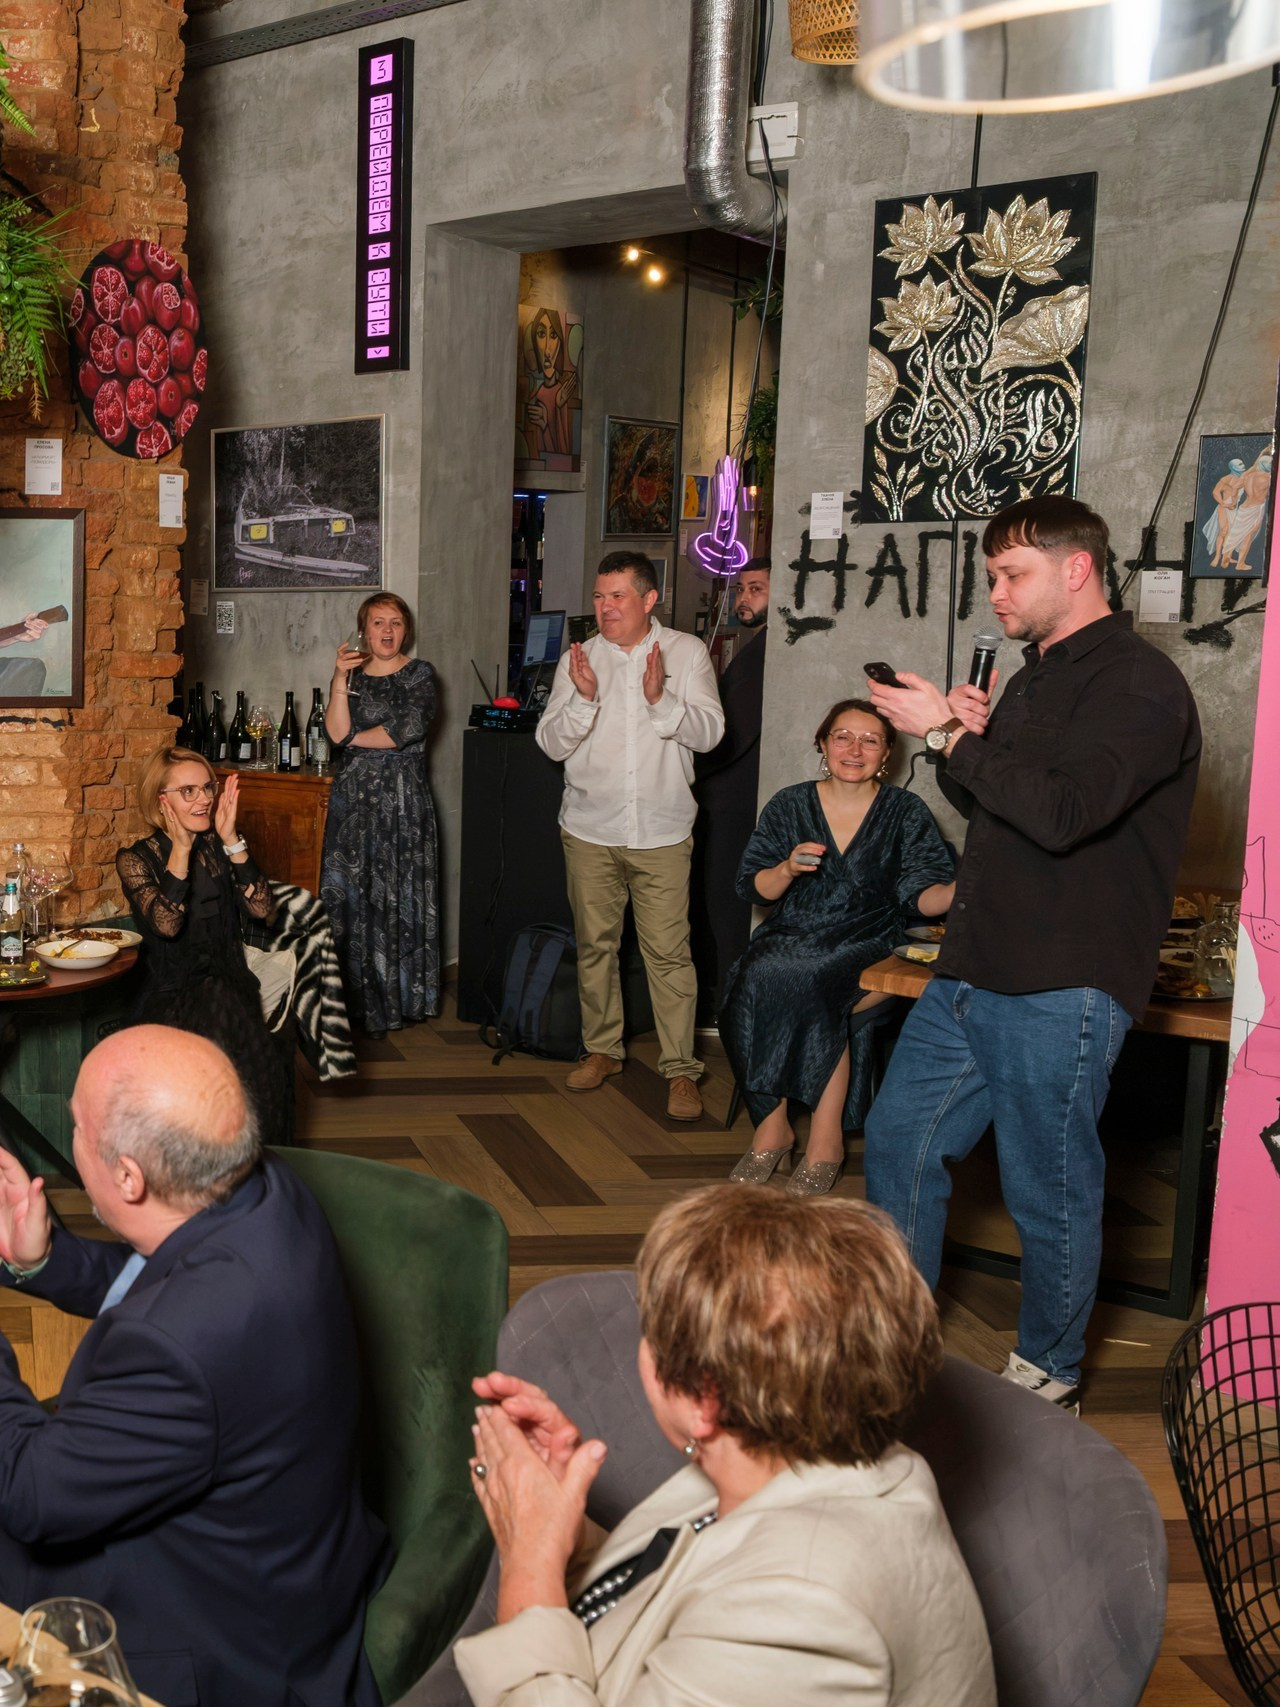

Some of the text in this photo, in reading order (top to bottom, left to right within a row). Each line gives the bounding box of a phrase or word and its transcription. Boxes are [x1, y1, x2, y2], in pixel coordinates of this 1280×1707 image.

[370, 96, 390, 334] ПЕРЕЙДЁМ К СУТИ
